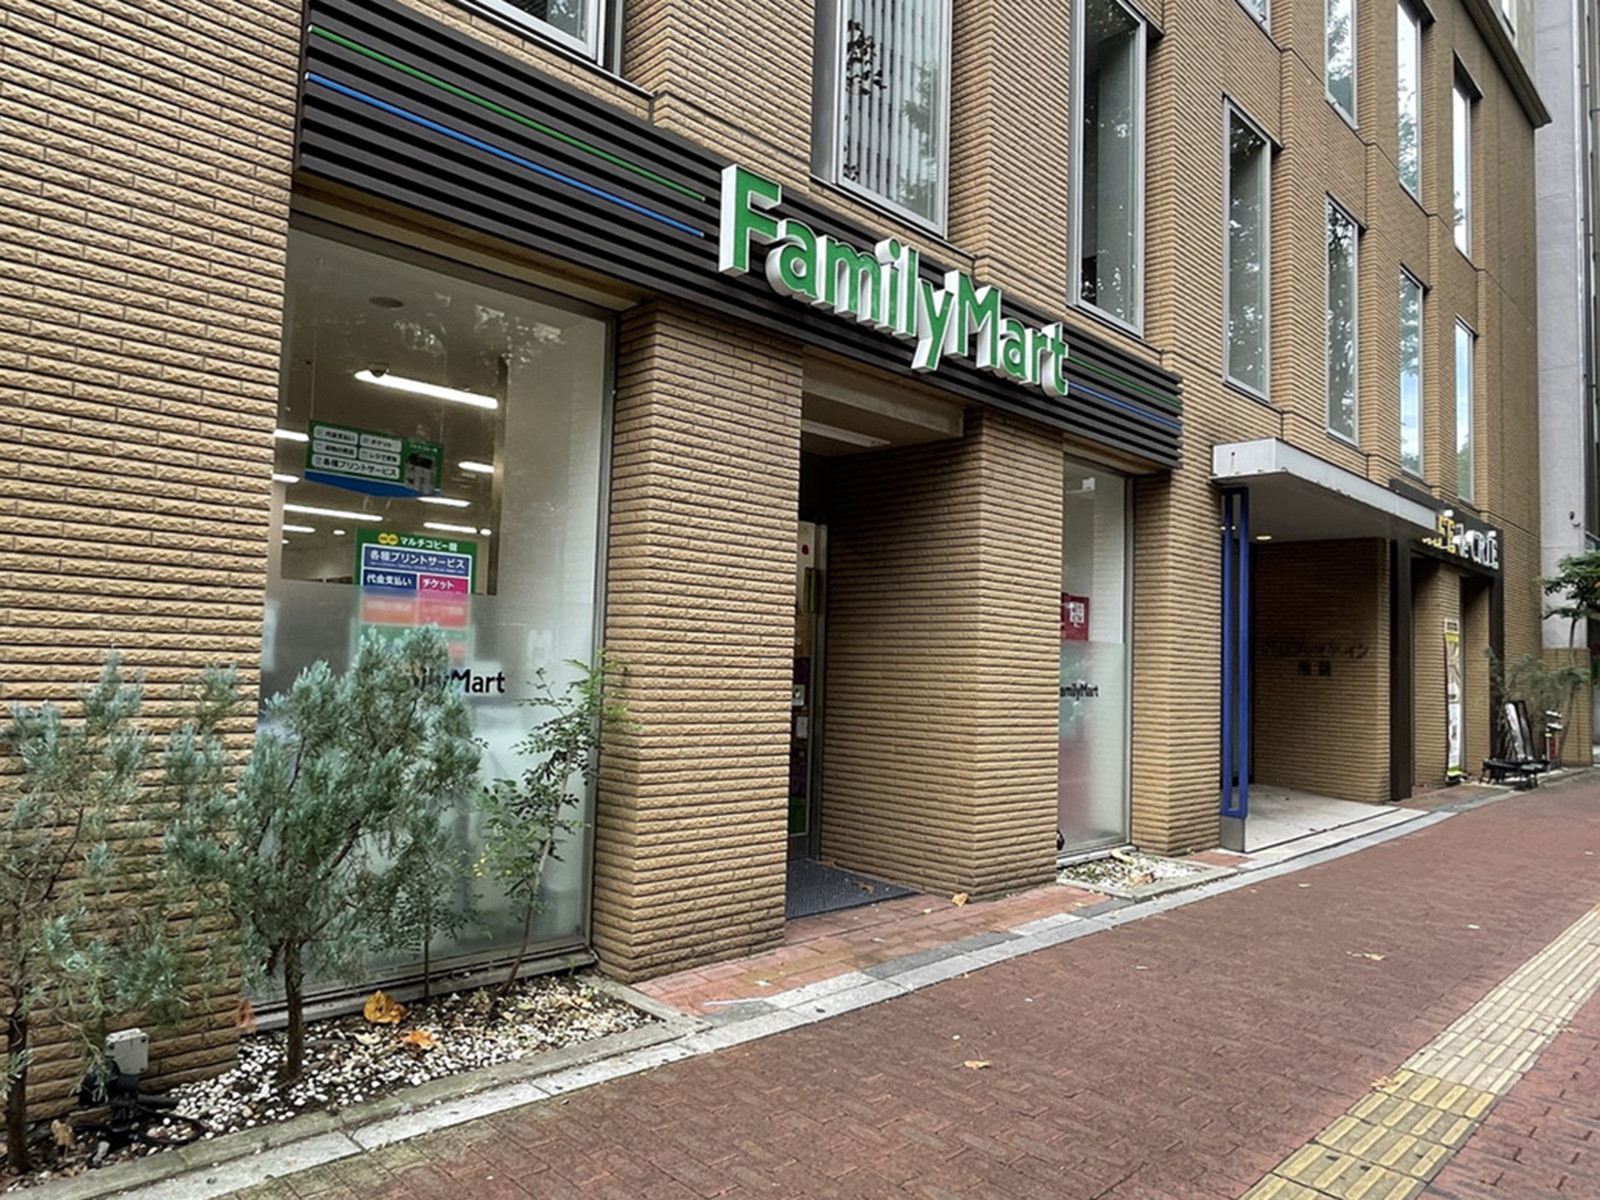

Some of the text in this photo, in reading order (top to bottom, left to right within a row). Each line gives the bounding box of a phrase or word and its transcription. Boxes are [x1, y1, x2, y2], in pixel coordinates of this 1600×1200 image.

[719, 164, 1069, 397] FamilyMart
[370, 549, 466, 570] 各種プリントサービス
[366, 574, 413, 588] 代金支払い
[422, 578, 455, 591] チケット
